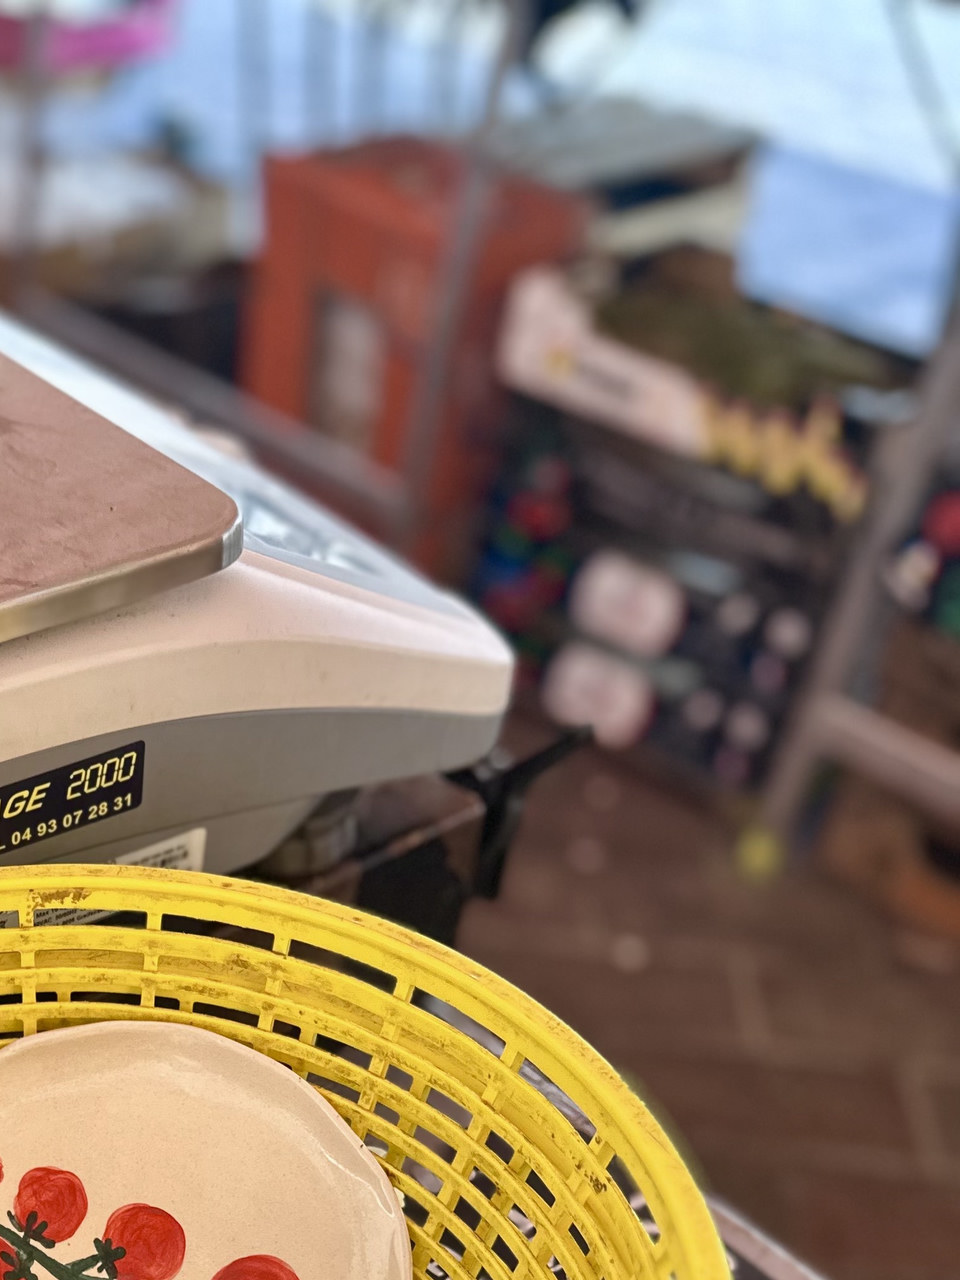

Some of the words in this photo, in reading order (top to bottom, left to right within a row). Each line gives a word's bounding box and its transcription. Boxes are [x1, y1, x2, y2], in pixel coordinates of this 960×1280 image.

[66, 751, 138, 800] 2000
[11, 830, 32, 846] 04
[37, 821, 58, 837] 93
[63, 813, 81, 829] 07
[88, 802, 108, 820] 28
[113, 793, 133, 811] 31
